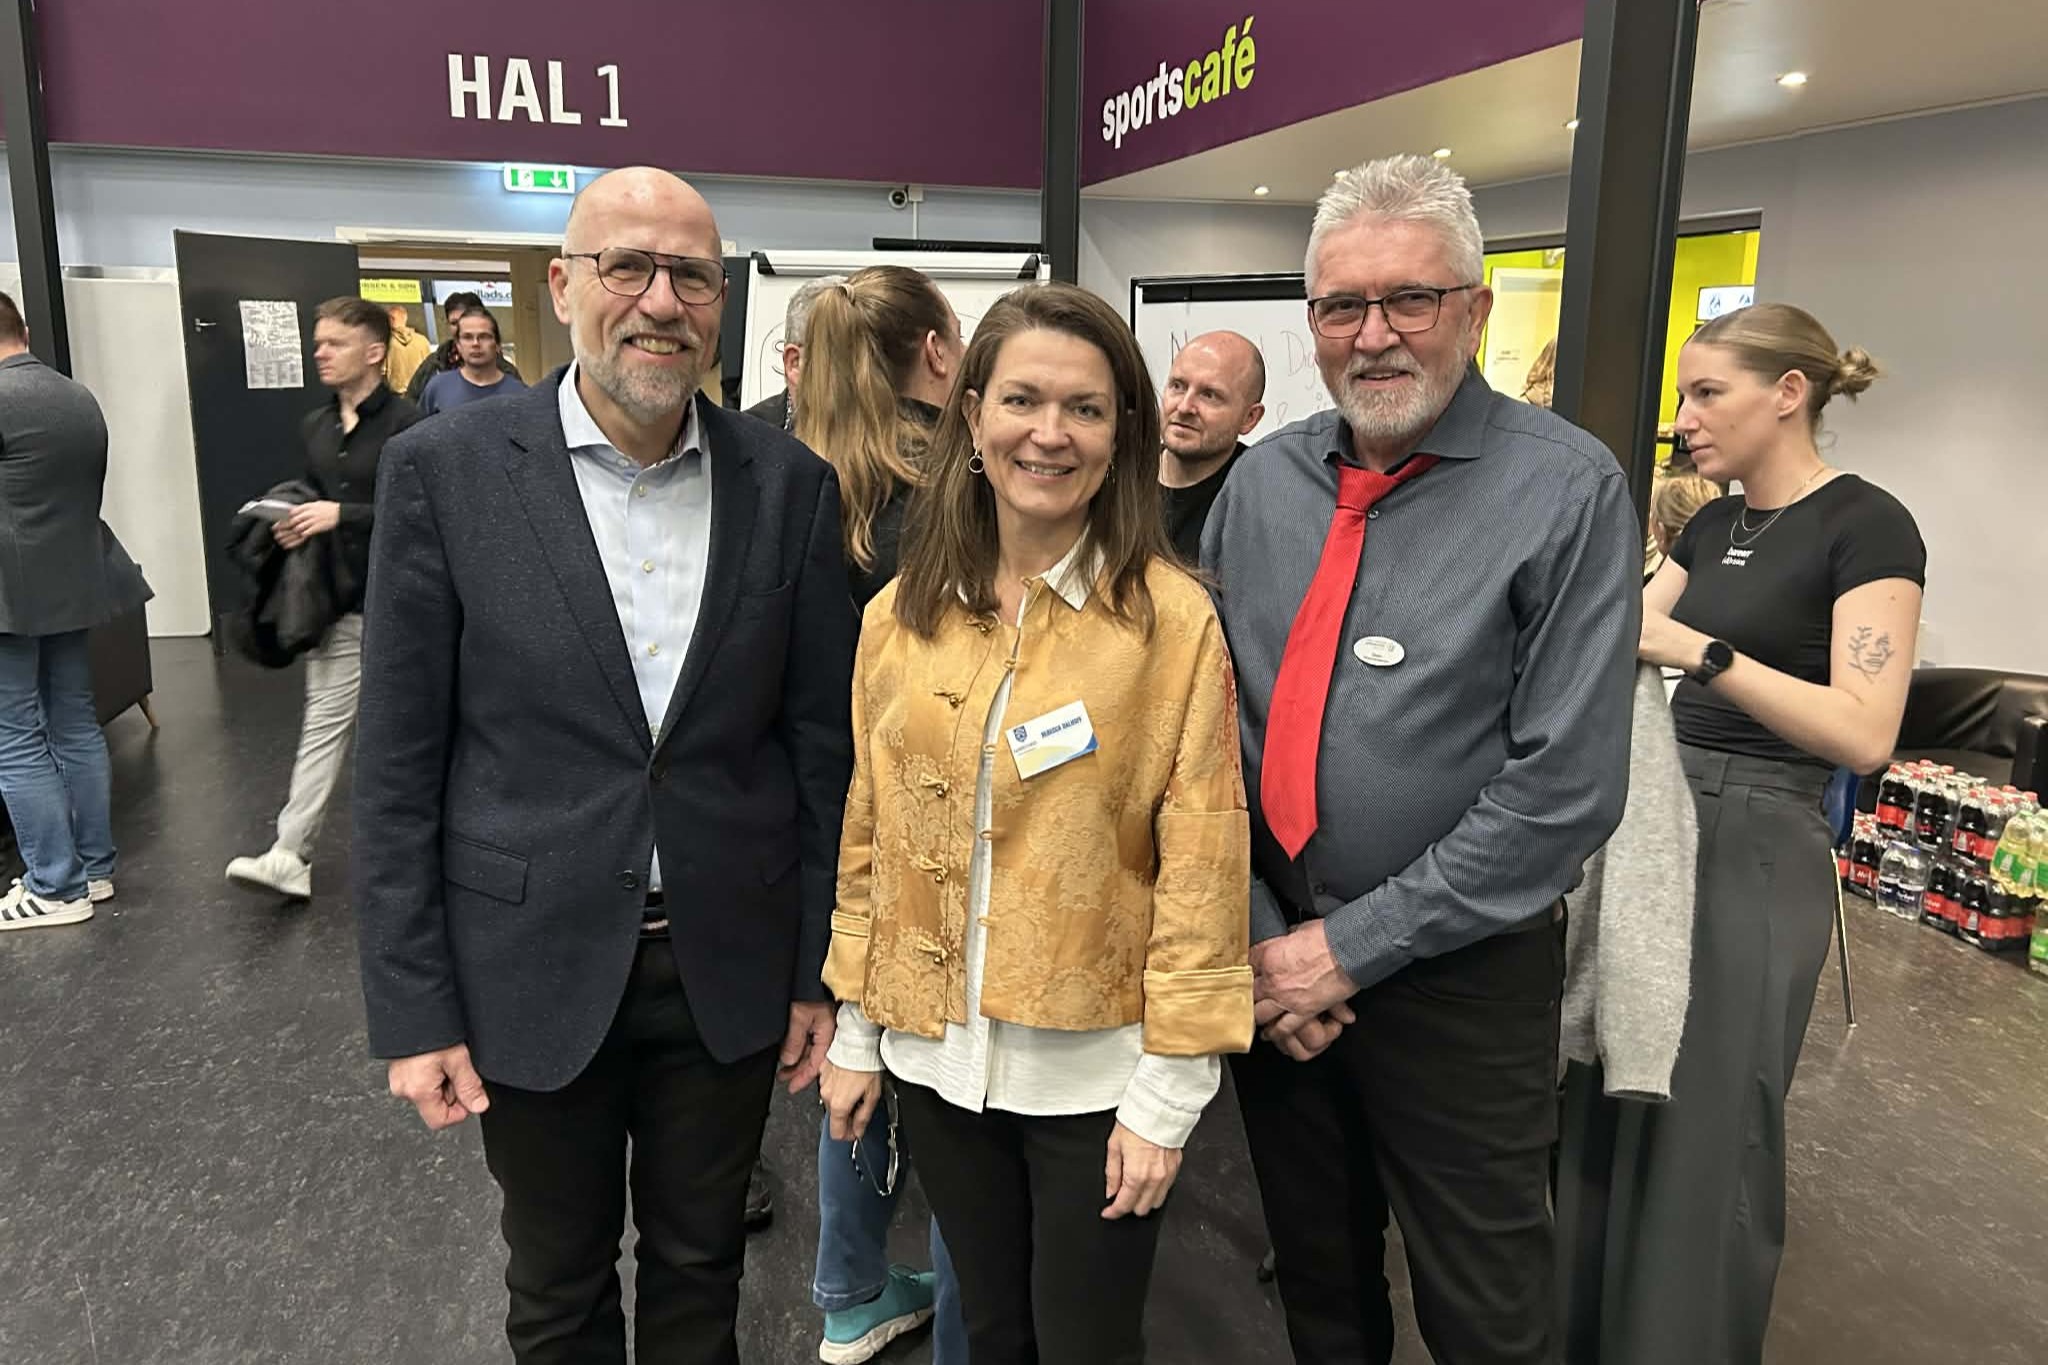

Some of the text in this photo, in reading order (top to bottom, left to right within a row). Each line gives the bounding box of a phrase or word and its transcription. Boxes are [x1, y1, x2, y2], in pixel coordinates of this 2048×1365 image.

[448, 54, 628, 127] HAL 1
[1102, 15, 1256, 149] sportscafé
